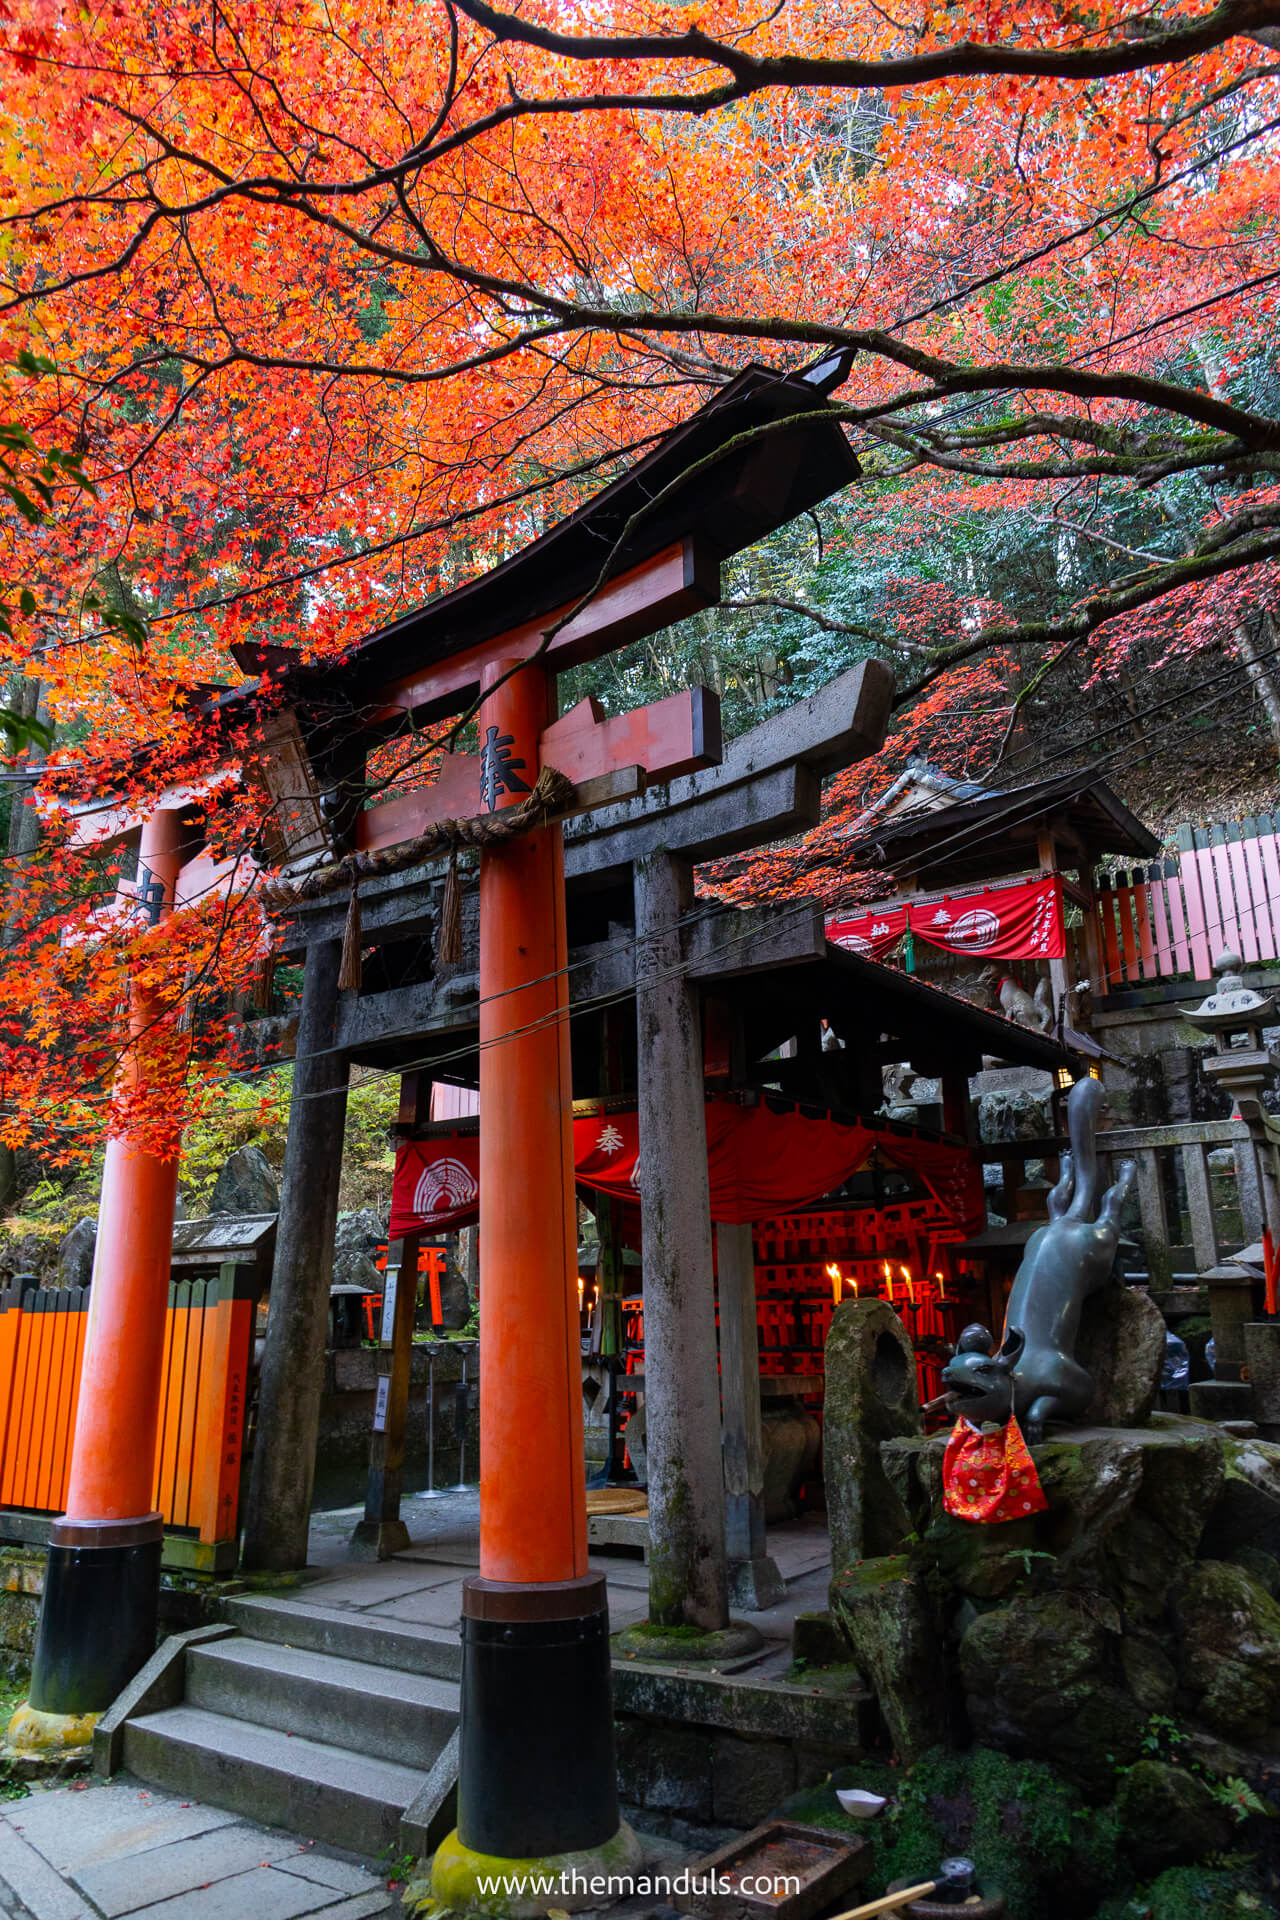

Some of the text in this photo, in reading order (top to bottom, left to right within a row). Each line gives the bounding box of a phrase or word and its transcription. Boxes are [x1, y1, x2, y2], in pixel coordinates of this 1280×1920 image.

[480, 725, 534, 813] 奉
[870, 909, 952, 939] 納 奉
[594, 1124, 625, 1156] 奉
